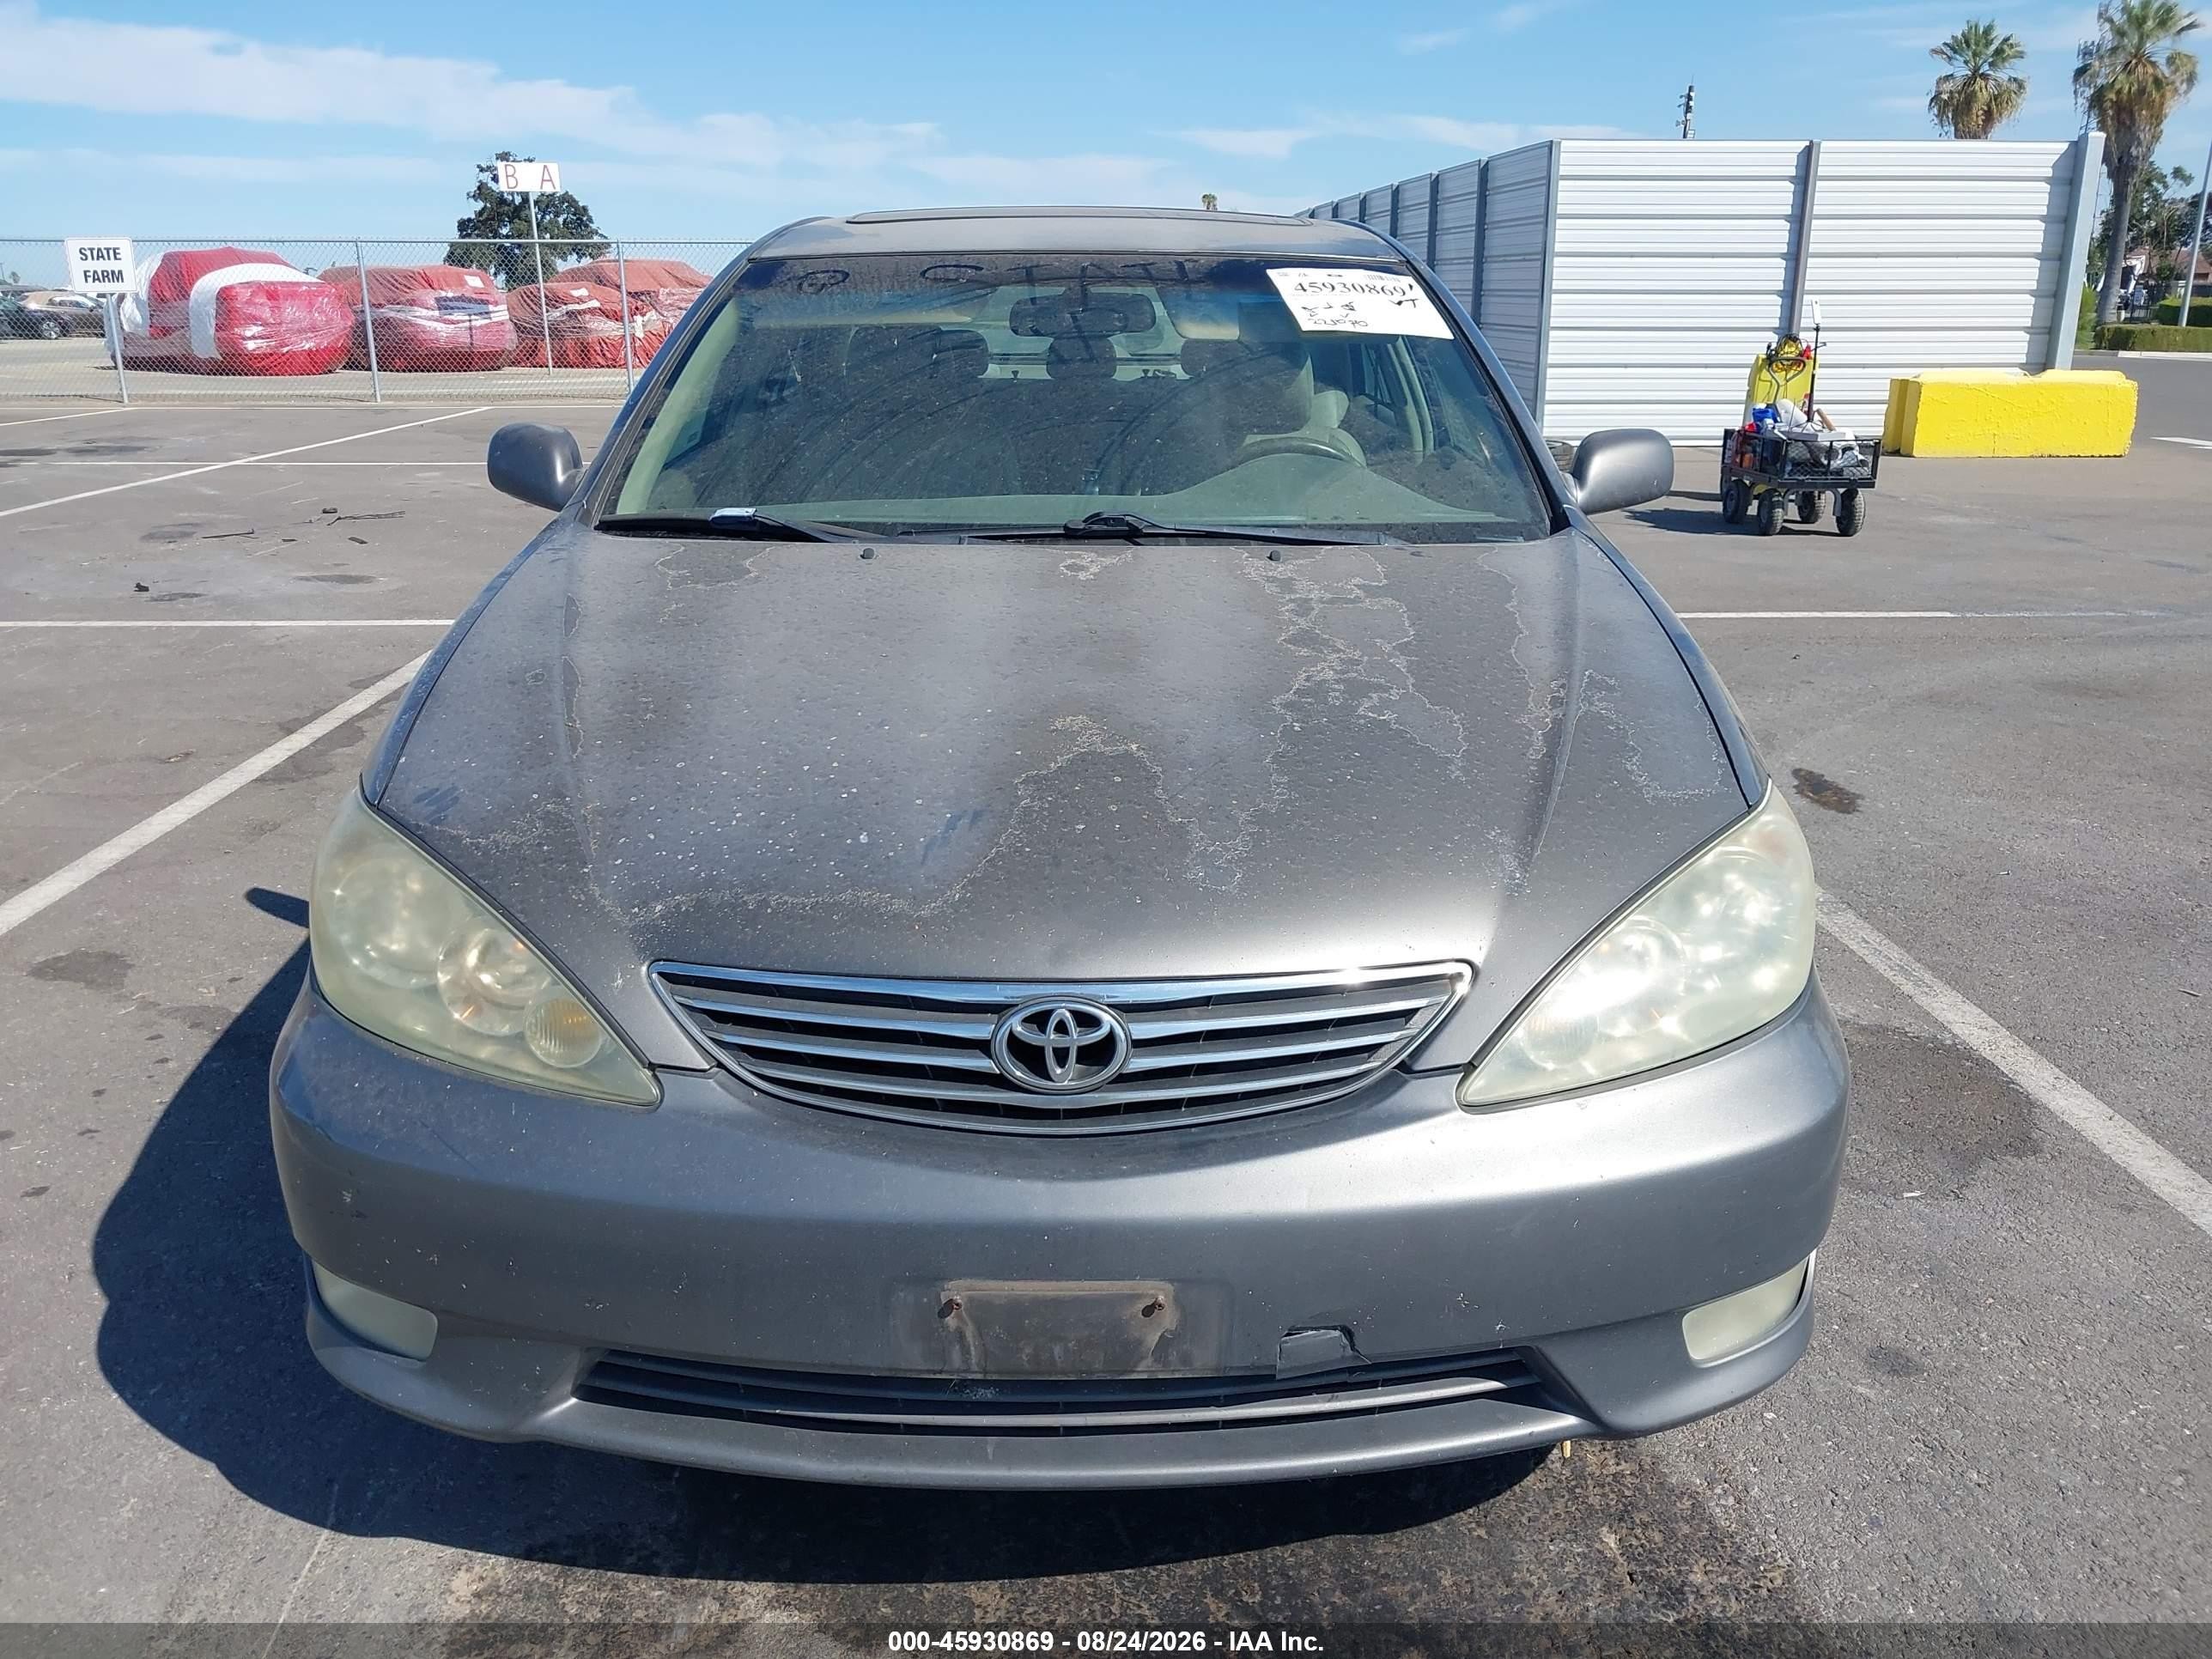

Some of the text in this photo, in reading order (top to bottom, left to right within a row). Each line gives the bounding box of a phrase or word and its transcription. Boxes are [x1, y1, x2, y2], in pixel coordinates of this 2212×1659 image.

[505, 164, 556, 190] B A
[79, 247, 122, 261] STATE
[83, 270, 125, 283] FARM
[1294, 282, 1406, 297] 45930869
